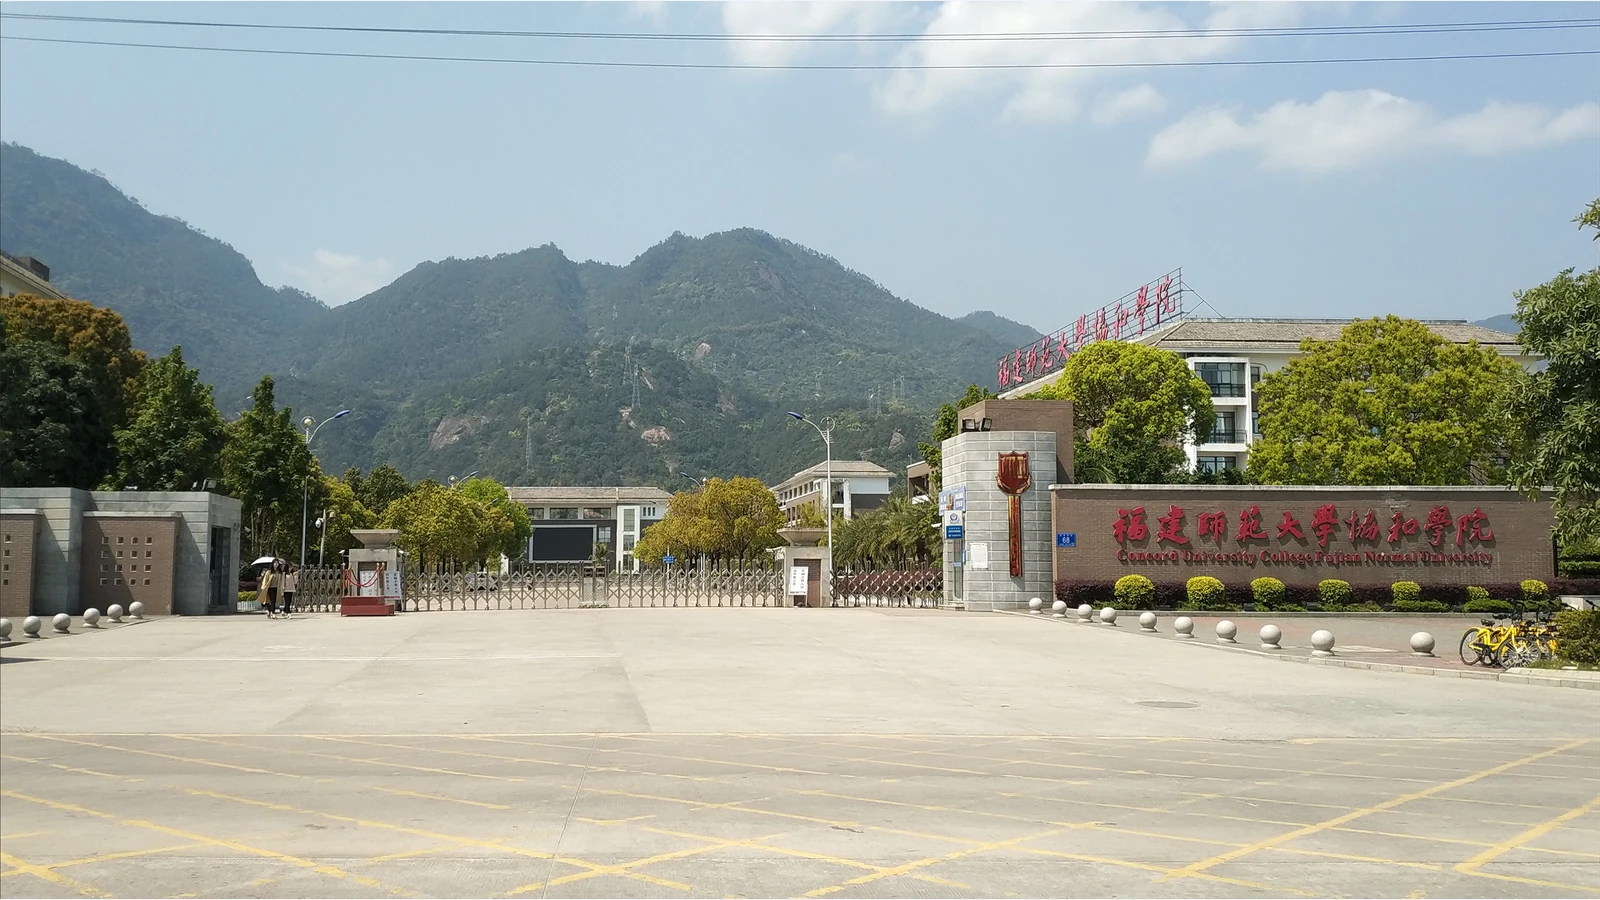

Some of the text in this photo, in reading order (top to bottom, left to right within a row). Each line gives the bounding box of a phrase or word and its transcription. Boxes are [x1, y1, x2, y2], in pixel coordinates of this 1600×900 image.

[1117, 549, 1492, 564] Concord University College Fujian Normal University
